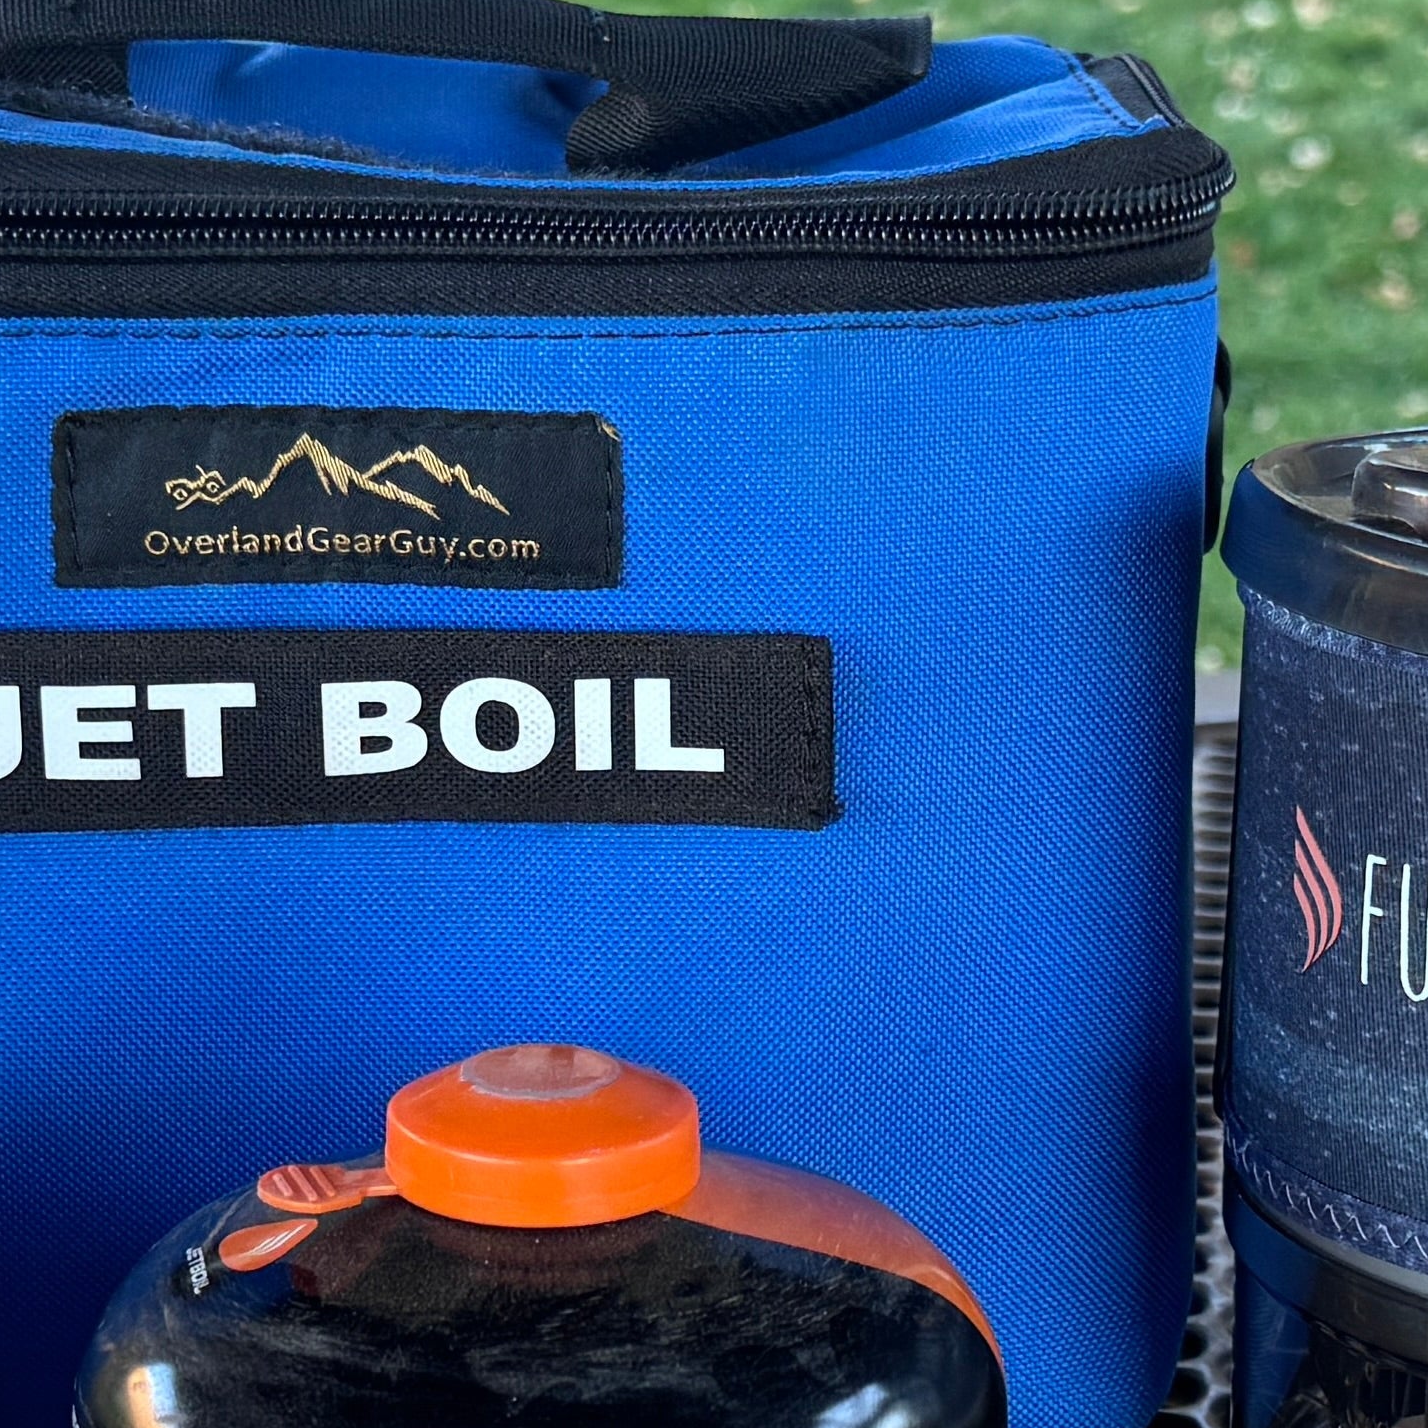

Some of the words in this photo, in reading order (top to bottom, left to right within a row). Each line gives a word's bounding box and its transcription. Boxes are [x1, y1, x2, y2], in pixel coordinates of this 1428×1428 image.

[143, 523, 543, 563] OverlandGearGuy.com
[320, 676, 726, 779] BOIL
[186, 1245, 211, 1296] JETBOIL
